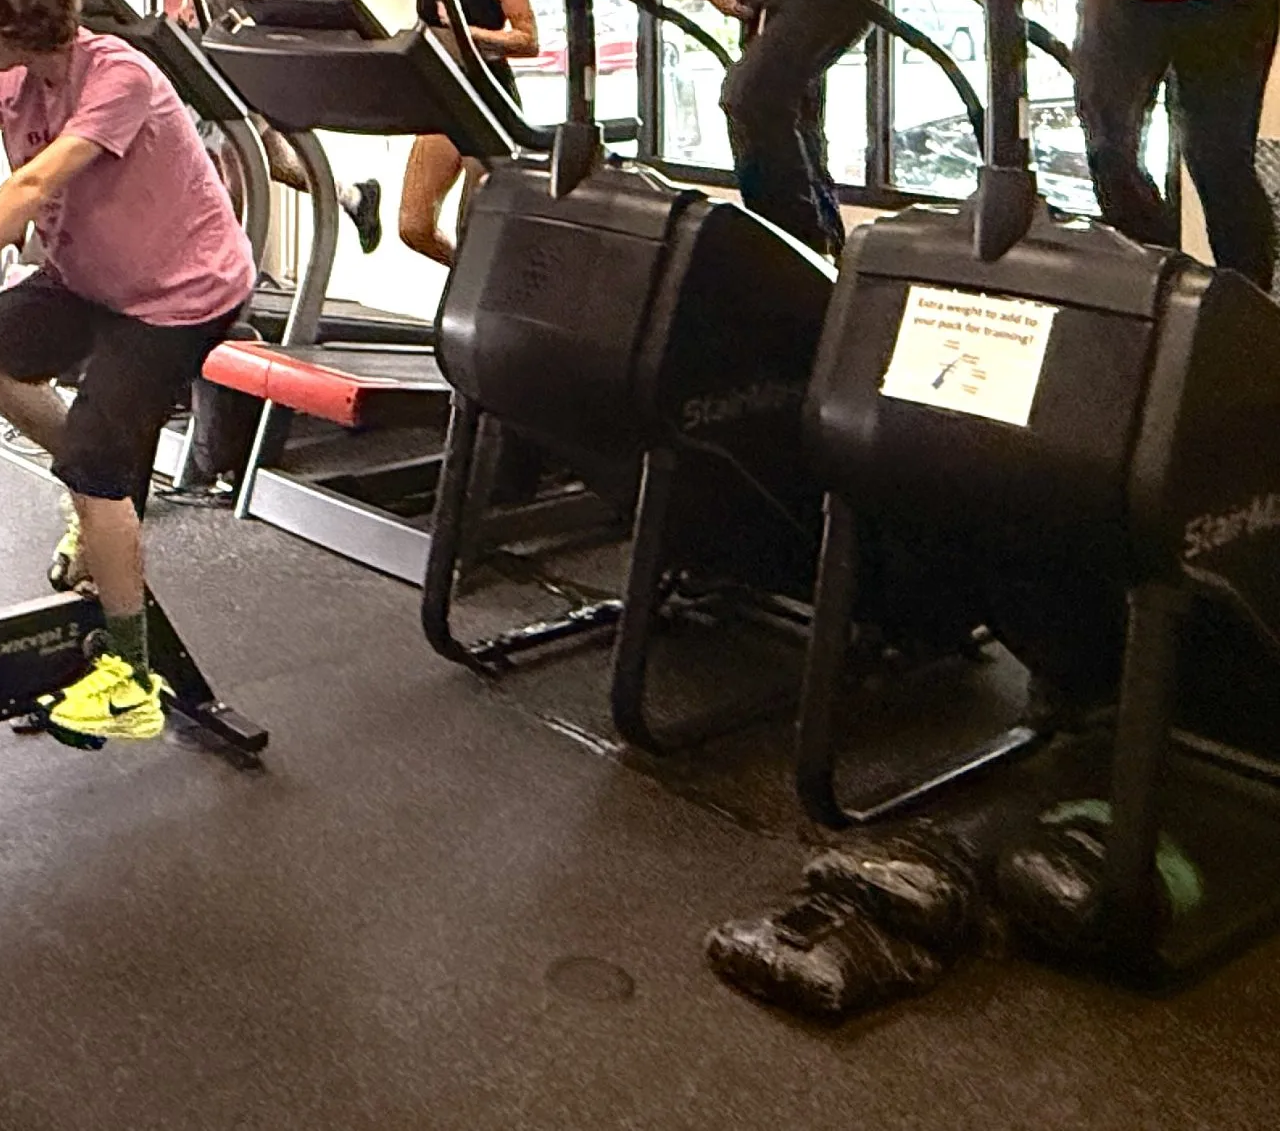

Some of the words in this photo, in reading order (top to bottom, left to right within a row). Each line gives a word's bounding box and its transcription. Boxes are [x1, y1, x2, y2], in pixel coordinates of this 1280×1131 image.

[918, 298, 944, 310] Extra
[946, 305, 983, 317] weight
[985, 309, 997, 320] to
[1000, 313, 1022, 324] add
[1025, 317, 1038, 327] to
[914, 316, 936, 327] your
[938, 320, 962, 331] pack
[965, 322, 980, 334] for
